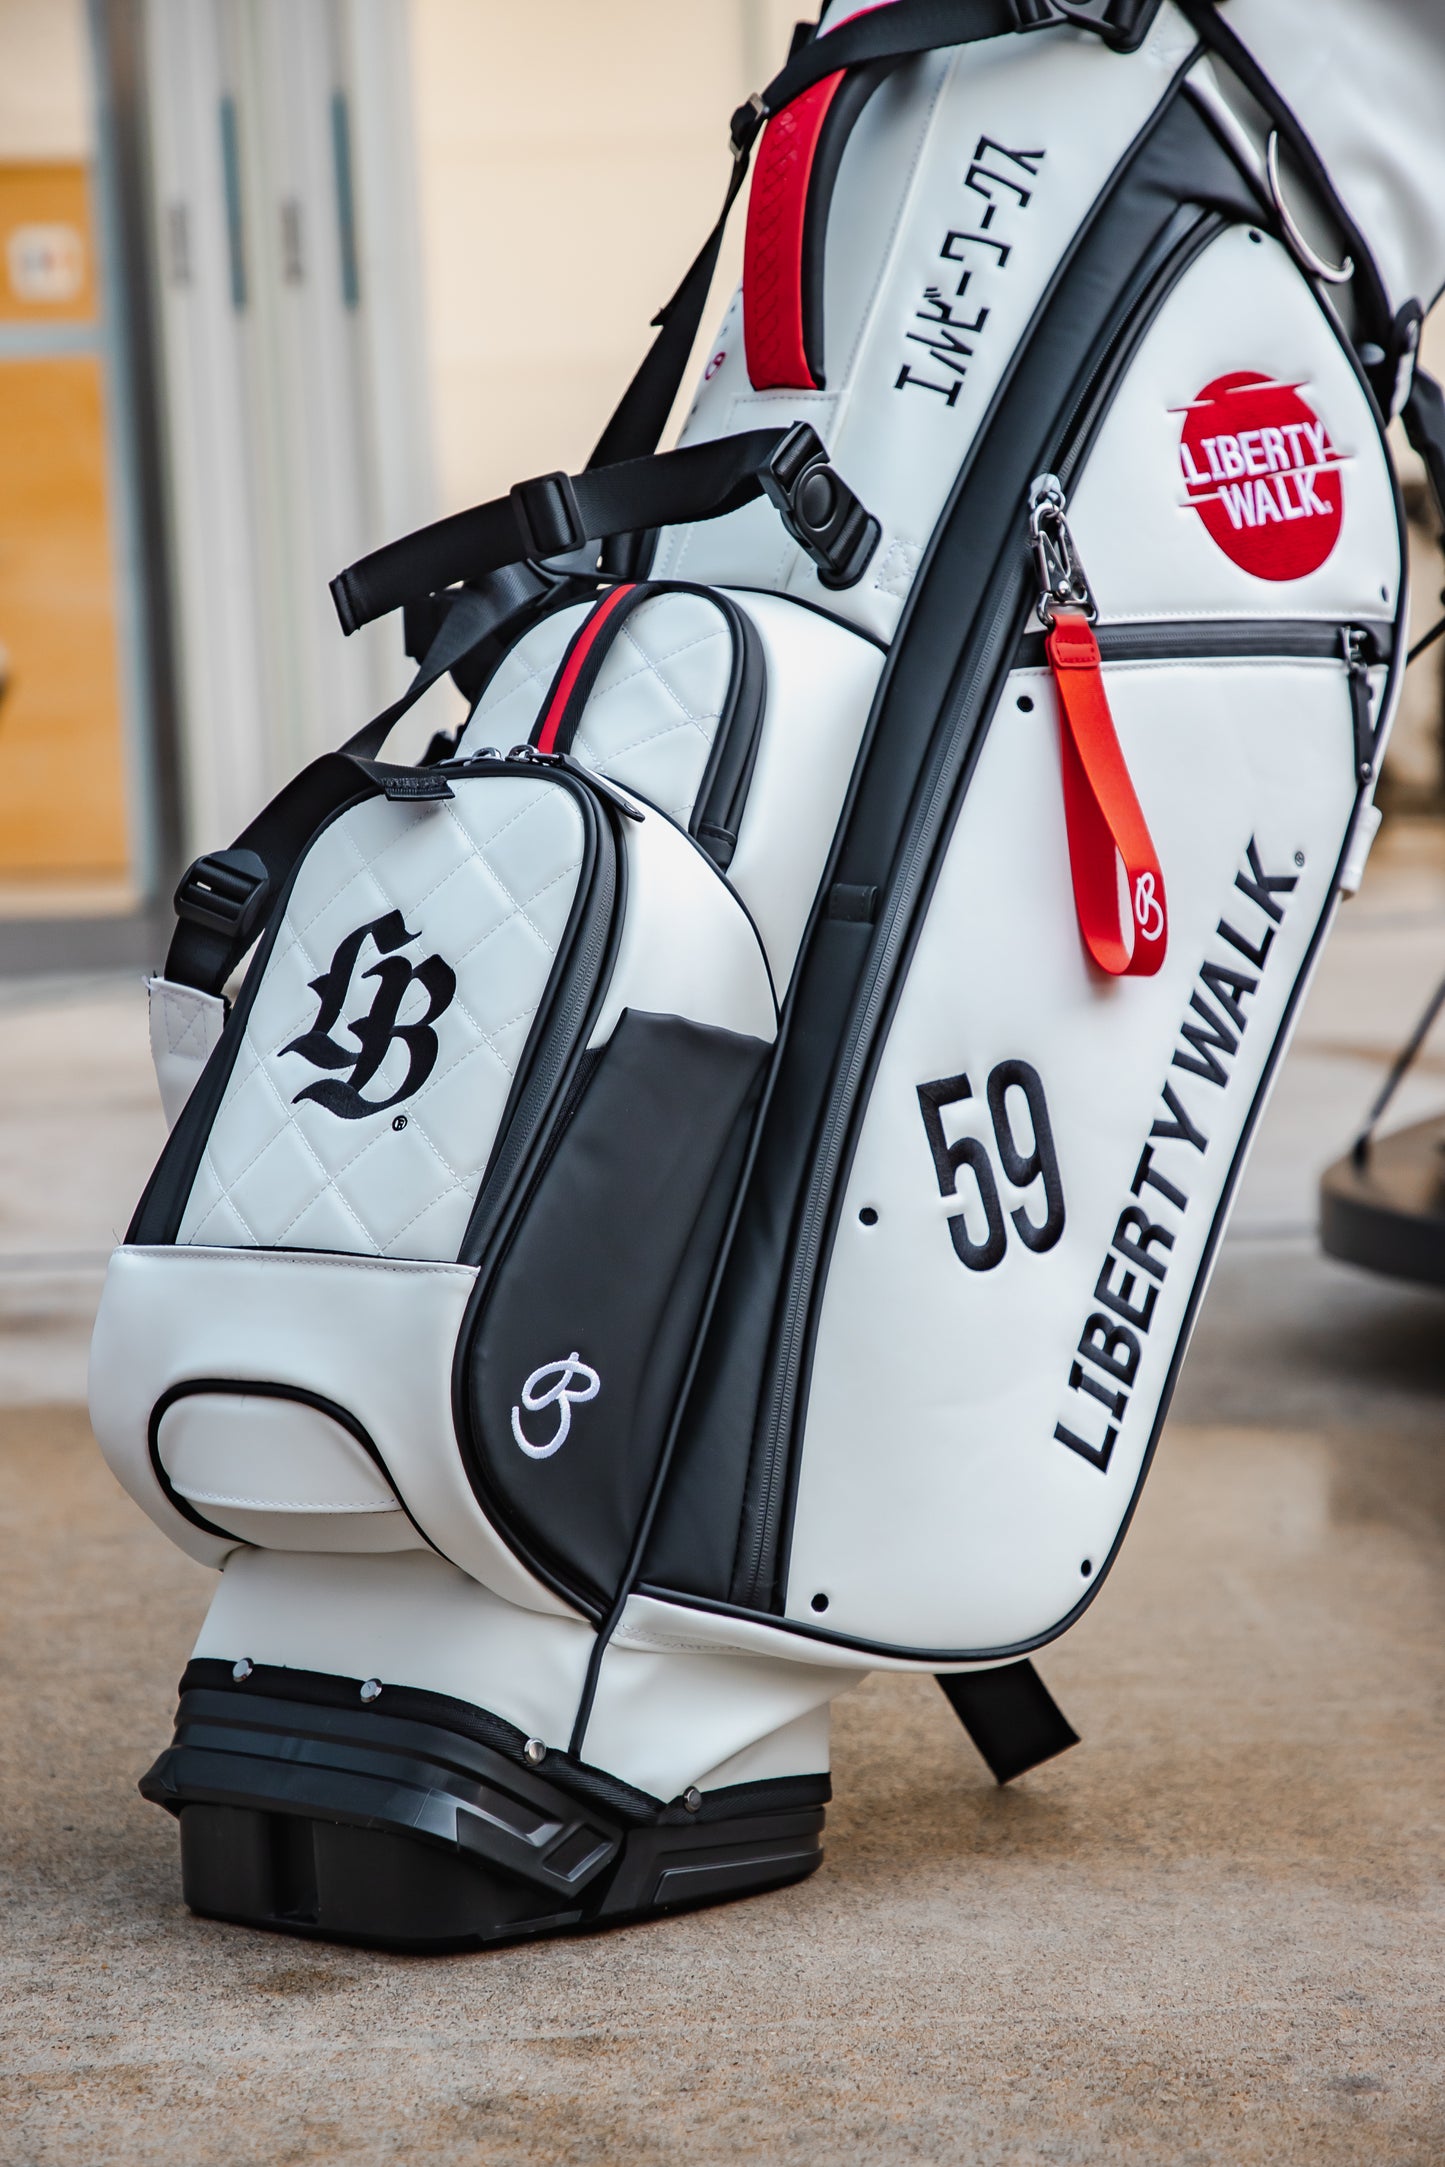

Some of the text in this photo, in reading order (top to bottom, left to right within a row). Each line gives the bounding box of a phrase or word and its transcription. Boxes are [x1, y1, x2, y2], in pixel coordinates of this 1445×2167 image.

[894, 134, 1046, 408] エルビーワークス
[1180, 420, 1327, 486] LIBERTY
[916, 1059, 1067, 1272] 59
[1053, 1080, 1209, 1476] LIBERTY
